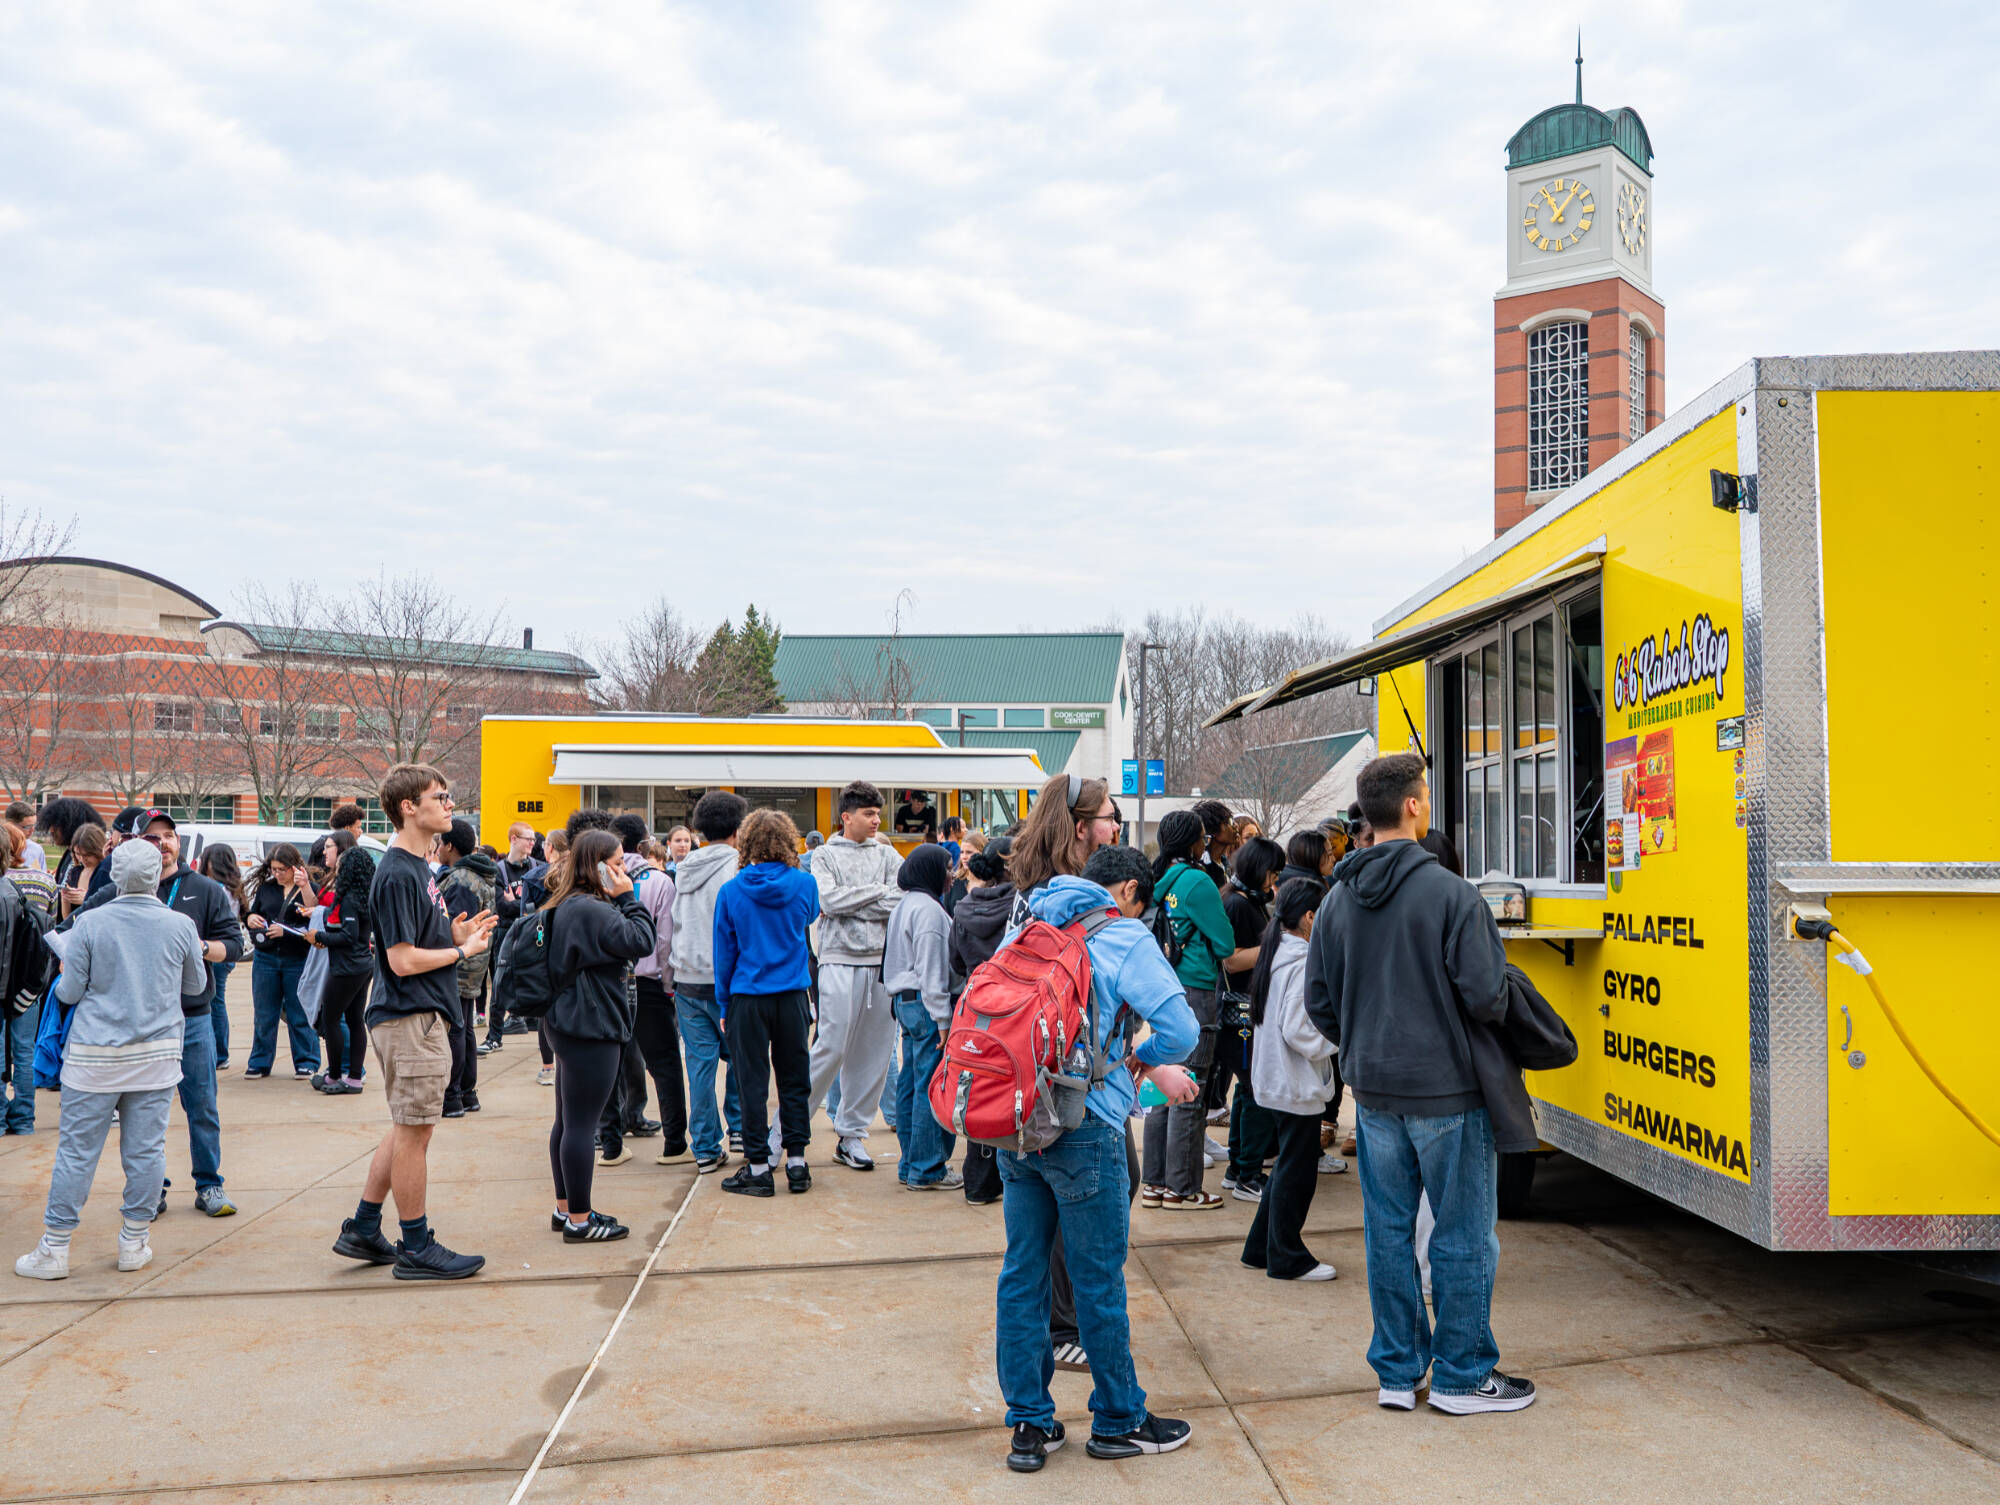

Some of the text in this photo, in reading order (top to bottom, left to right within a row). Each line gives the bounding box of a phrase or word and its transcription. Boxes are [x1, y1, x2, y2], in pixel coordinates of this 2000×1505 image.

[1638, 619, 1692, 708] Kabob
[1690, 613, 1729, 701] Stop
[1628, 691, 1715, 729] MEDITERRANEAN CUISINE
[517, 800, 544, 813] BAE
[1603, 912, 1704, 949] FALAFEL
[1603, 969, 1661, 1006] GYRO
[1604, 1029, 1716, 1088] BURGERS
[1604, 1092, 1749, 1176] SHAWARMA
